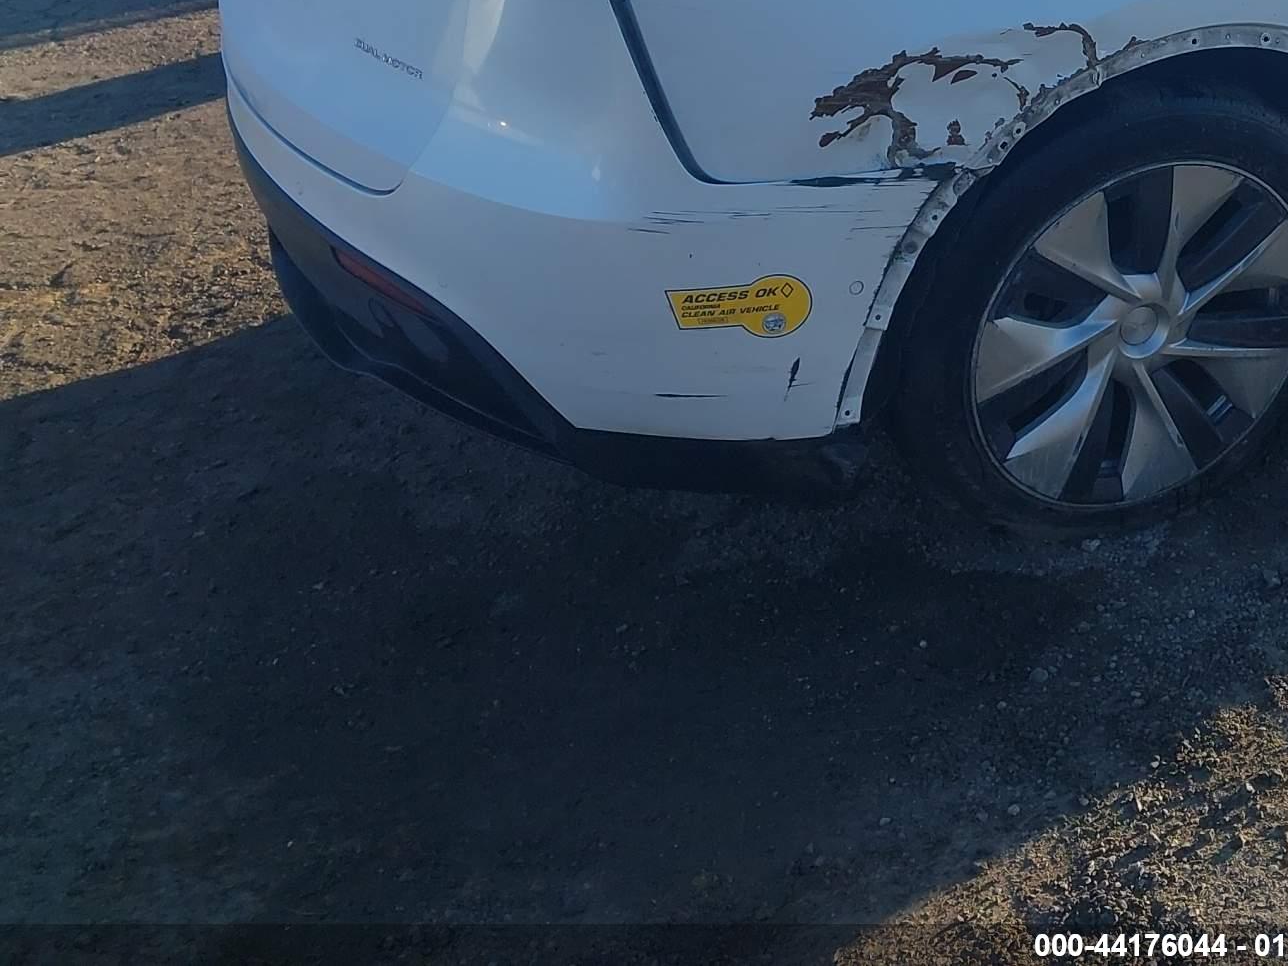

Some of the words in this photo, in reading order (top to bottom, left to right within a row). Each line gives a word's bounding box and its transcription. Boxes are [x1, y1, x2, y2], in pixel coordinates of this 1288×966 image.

[682, 290, 749, 304] ACCESS
[755, 287, 779, 298] OK
[681, 310, 716, 318] CLEAN
[718, 308, 737, 316] AIR
[740, 304, 781, 314] VEHICLE
